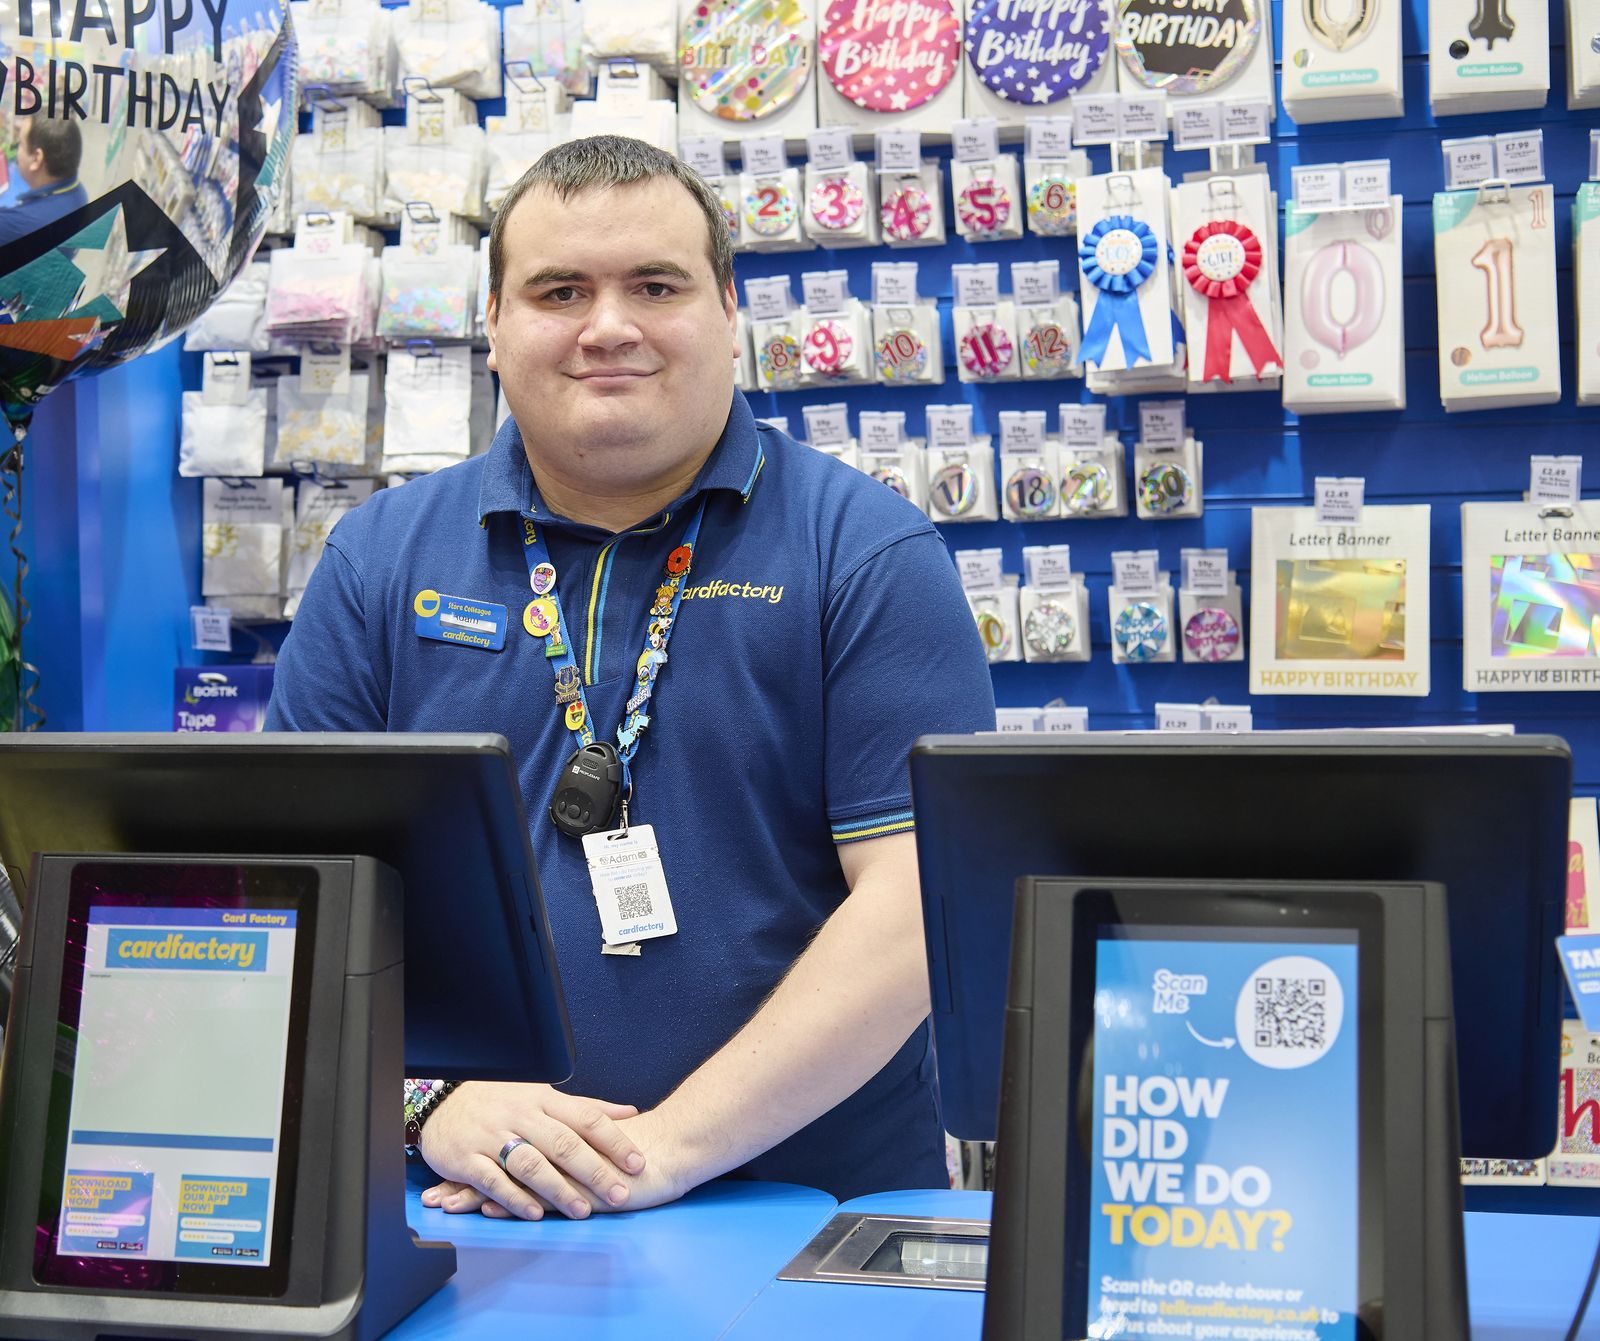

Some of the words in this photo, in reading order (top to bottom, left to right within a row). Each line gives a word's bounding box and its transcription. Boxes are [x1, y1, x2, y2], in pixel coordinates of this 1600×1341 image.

[1121, 12, 1256, 48] BIRTHDAY
[834, 38, 947, 86] Birthday
[976, 29, 1093, 80] Birthday
[15, 57, 232, 138] BIRTHDAY
[1506, 142, 1529, 151] £7.99
[1458, 154, 1480, 163] £7.99
[758, 188, 780, 216] 2
[824, 184, 847, 221] 3
[1045, 183, 1067, 210] 6
[969, 187, 997, 228] 5
[812, 328, 840, 365] 9
[882, 332, 915, 365] 10
[970, 331, 999, 368] 11
[1031, 328, 1063, 356] 12
[770, 342, 788, 369] 8
[1466, 371, 1497, 384] Helium
[1499, 370, 1532, 382] Balloon
[1542, 467, 1567, 476] £2.49
[1013, 476, 1047, 509] 18
[1143, 471, 1185, 505] 30
[1290, 532, 1332, 547] Letter
[1337, 533, 1390, 546] Banner
[1504, 528, 1547, 543] Letter
[1552, 529, 1600, 542] Banne
[681, 580, 784, 604] ardfactory
[448, 601, 463, 611] Store
[464, 604, 491, 616] Colleague
[442, 631, 490, 647] cardfactory
[1261, 671, 1320, 687] HAPPY
[1324, 671, 1418, 688] BIRTHDAY
[1477, 670, 1532, 684] HAPPY
[1552, 669, 1600, 684] BIRTH
[193, 685, 239, 698] BOSTIK
[178, 711, 216, 730] Tape
[1002, 724, 1023, 732] £1.29
[1051, 723, 1072, 731] £1.29
[1166, 720, 1187, 728] £1.29
[1215, 721, 1237, 730] £1.29
[609, 852, 637, 864] Adam
[222, 913, 246, 924] Card
[249, 913, 287, 926] Factory
[618, 921, 664, 936] cardfactory
[118, 933, 256, 967] cardfactory
[1155, 971, 1206, 993] Scan
[1155, 993, 1188, 1012] Me
[1103, 1074, 1230, 1118] HOW
[1102, 1117, 1189, 1160] DID
[69, 1187, 90, 1197] OUR
[93, 1189, 111, 1198] APP
[70, 1178, 128, 1189] DOWNLOAD
[183, 1183, 243, 1195] DOWNLOAD
[1103, 1160, 1184, 1204] WE
[1195, 1164, 1272, 1207] DO
[69, 1197, 96, 1207] NOW!
[182, 1203, 211, 1212] NOW!
[183, 1193, 204, 1203] OUR
[208, 1194, 226, 1203] APP
[1101, 1203, 1293, 1252] TODAY?
[1101, 1275, 1139, 1294] Scan
[1141, 1277, 1167, 1295] the
[1168, 1280, 1194, 1297] QR
[1195, 1281, 1233, 1298] code
[1235, 1282, 1283, 1301] above
[1285, 1289, 1304, 1302] or
[1141, 1298, 1158, 1314] to
[1159, 1299, 1319, 1325] tellcardfactory.co.uk
[1321, 1307, 1339, 1324] to
[1127, 1321, 1145, 1333] us
[1147, 1317, 1193, 1335] about
[1195, 1324, 1231, 1341] your
